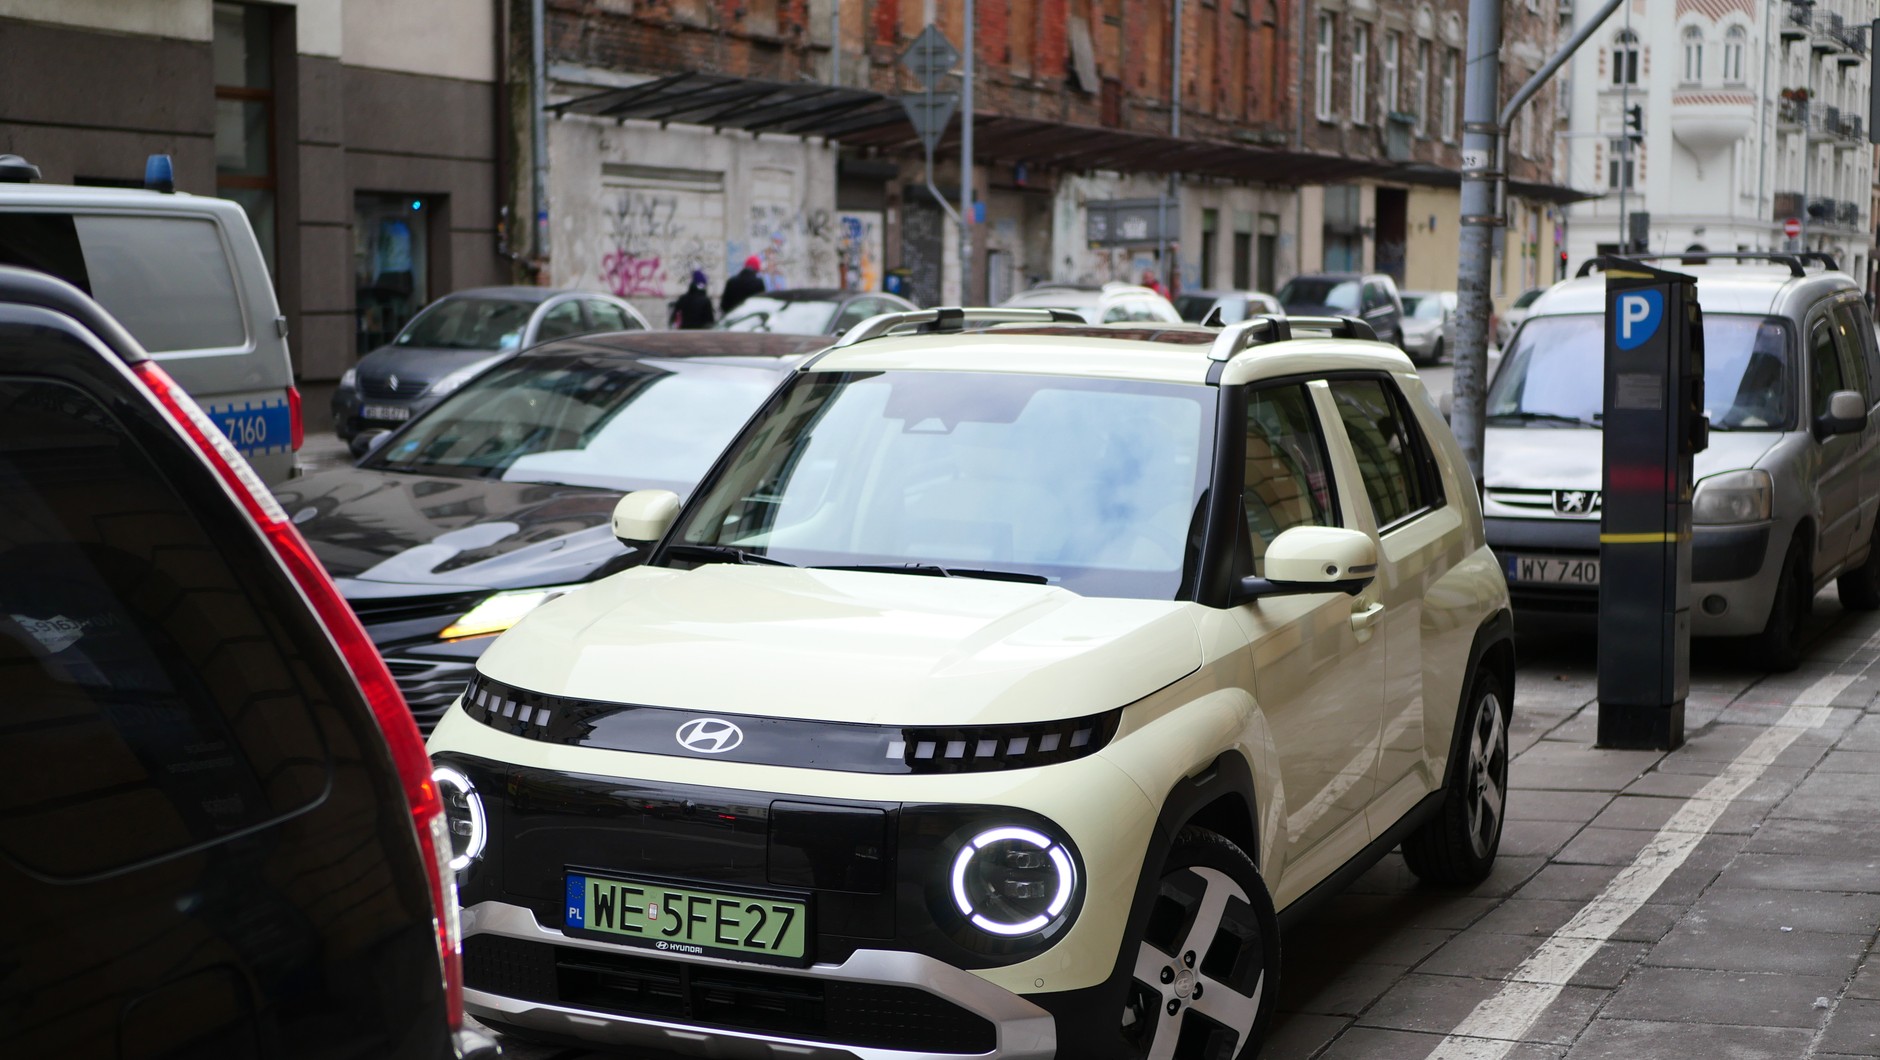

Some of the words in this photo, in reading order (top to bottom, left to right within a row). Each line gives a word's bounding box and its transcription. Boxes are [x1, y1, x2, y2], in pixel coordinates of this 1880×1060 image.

[1622, 295, 1650, 339] P
[1522, 560, 1548, 580] WY
[1558, 561, 1600, 583] 740
[569, 907, 582, 920] PL
[593, 882, 644, 933] WE
[661, 891, 795, 950] 5FE27
[670, 943, 703, 954] HYUNDAI
